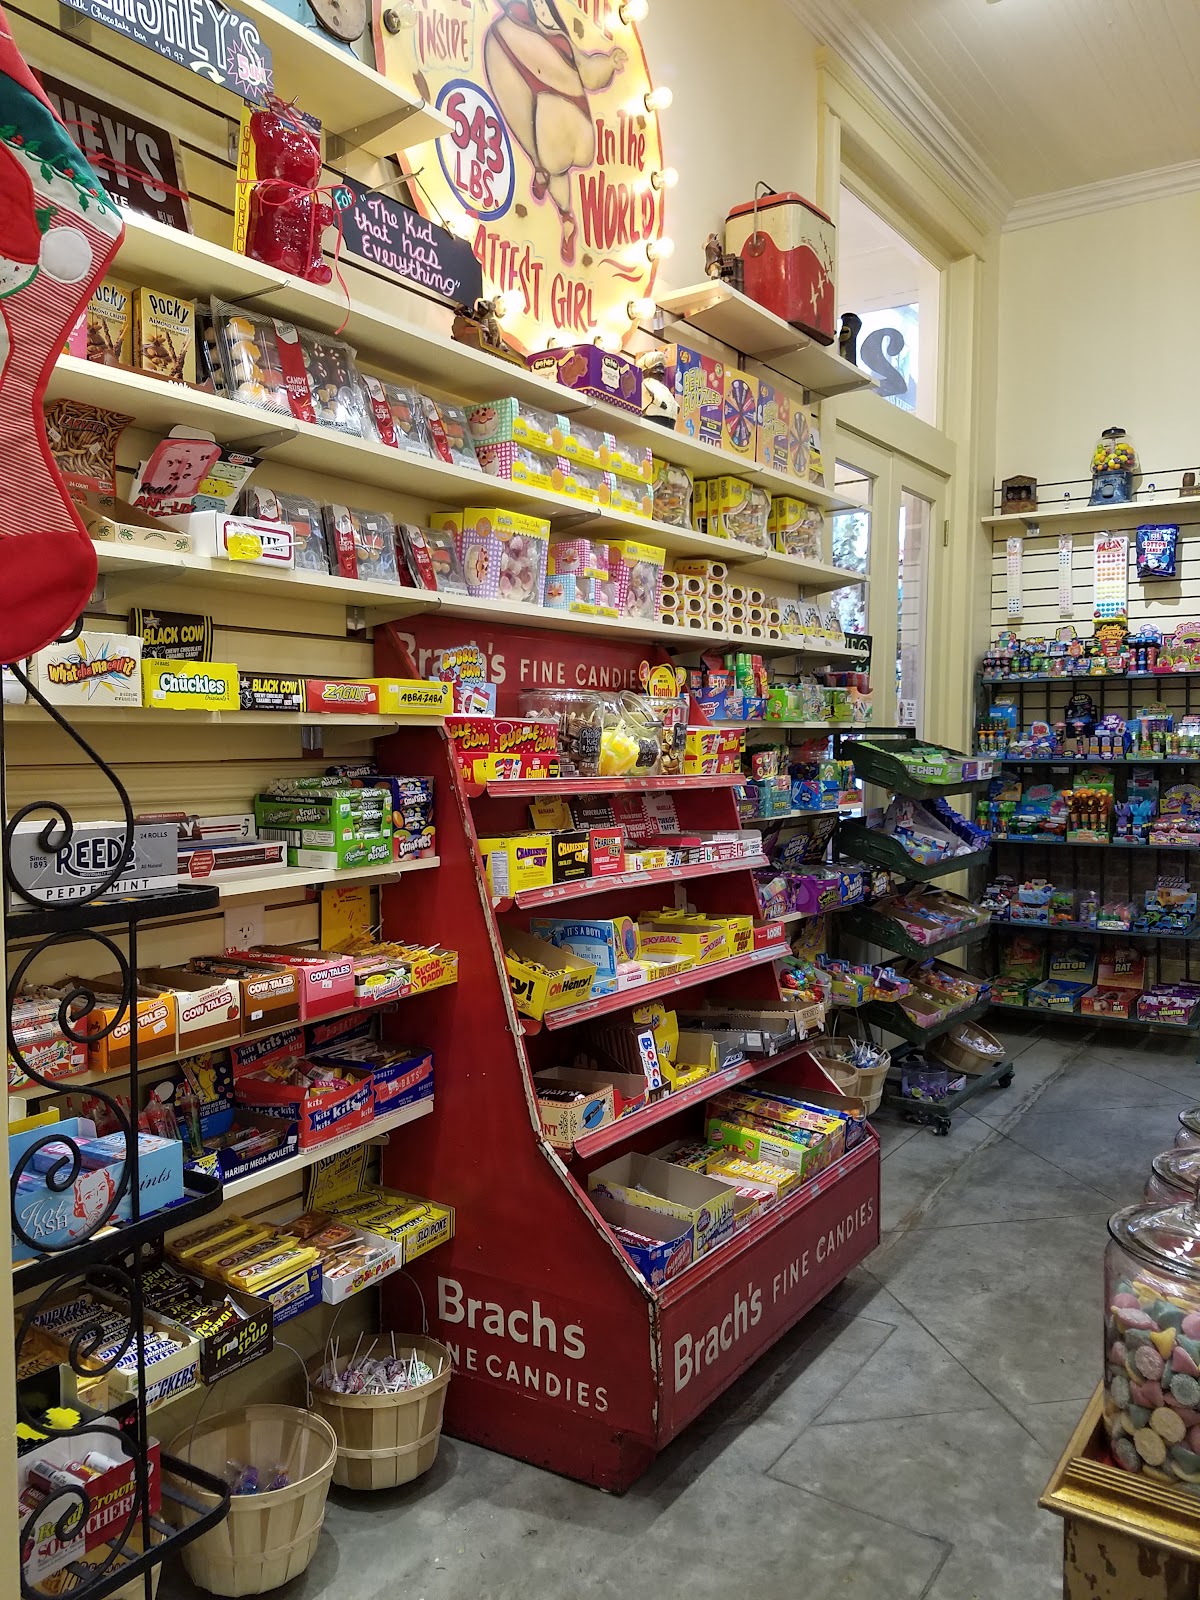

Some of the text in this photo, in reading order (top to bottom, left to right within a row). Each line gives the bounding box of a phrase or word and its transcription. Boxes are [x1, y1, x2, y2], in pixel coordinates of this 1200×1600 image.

[134, 29, 147, 42] bar
[417, 17, 469, 62] INSIDE
[596, 108, 646, 172] In The
[456, 159, 500, 209] LBS.
[578, 173, 656, 250] WORLD
[354, 207, 442, 270] that has
[403, 211, 438, 247] Kid
[148, 294, 190, 324] POCKY
[550, 273, 598, 333] GIRL
[148, 316, 190, 334] ALMOND CRUSH
[286, 375, 307, 385] CANDY
[137, 481, 178, 498] Real!
[1141, 540, 1168, 549] COTTON
[143, 623, 205, 646] BLACK COW
[442, 649, 478, 670] BUBBLE
[48, 656, 137, 685] Whatchamacallit
[460, 664, 481, 680] GUM
[520, 658, 566, 685] FINE
[252, 679, 298, 694] BLACK COW
[462, 733, 490, 750] GUM
[534, 735, 557, 753] GUM
[918, 765, 944, 777] CHEW
[296, 813, 322, 824] Pastilles
[299, 808, 318, 817] Fruit
[582, 808, 608, 816] CHOCOLATE
[626, 815, 676, 833] TURKISH TURKISH
[629, 824, 676, 839] TAFFY TAFFY
[140, 831, 168, 840] 24 ROLLS
[367, 850, 390, 862] Pastilles
[371, 843, 388, 853] Fruit
[29, 861, 48, 869] 1893
[567, 927, 579, 937] IT'S
[579, 928, 586, 936] A
[766, 925, 782, 941] LOOK!
[310, 963, 352, 983] COW TALES
[414, 959, 441, 979] SUGAR
[650, 963, 682, 981] EL BUBBLE
[1052, 961, 1087, 971] GATOR
[1115, 962, 1132, 973] RAT
[248, 974, 295, 996] COW TALES
[420, 966, 446, 987] DADDY
[549, 984, 562, 997] Oh
[562, 974, 592, 993] Henry!
[182, 991, 232, 1022] COW TALES
[1047, 996, 1070, 1004] GATOR
[1112, 1004, 1124, 1012] RAT
[138, 1005, 169, 1028] TALES
[256, 1034, 298, 1055] kits kits
[640, 1036, 661, 1089] BOSCO
[307, 1097, 324, 1109] kits
[315, 1097, 358, 1122] kits kits
[315, 1106, 374, 1133] kits kits
[224, 1144, 296, 1179] HARIBO MEGA-ROULETTE
[20, 1197, 66, 1231] Hot
[417, 1216, 448, 1243] SLO POKE
[672, 1197, 875, 1395] Brach's FINE CANDIES
[238, 1322, 268, 1356] SPUD
[166, 1378, 197, 1399] Almond
[485, 1353, 610, 1414] CANDIES
[88, 1479, 137, 1515] Crown
